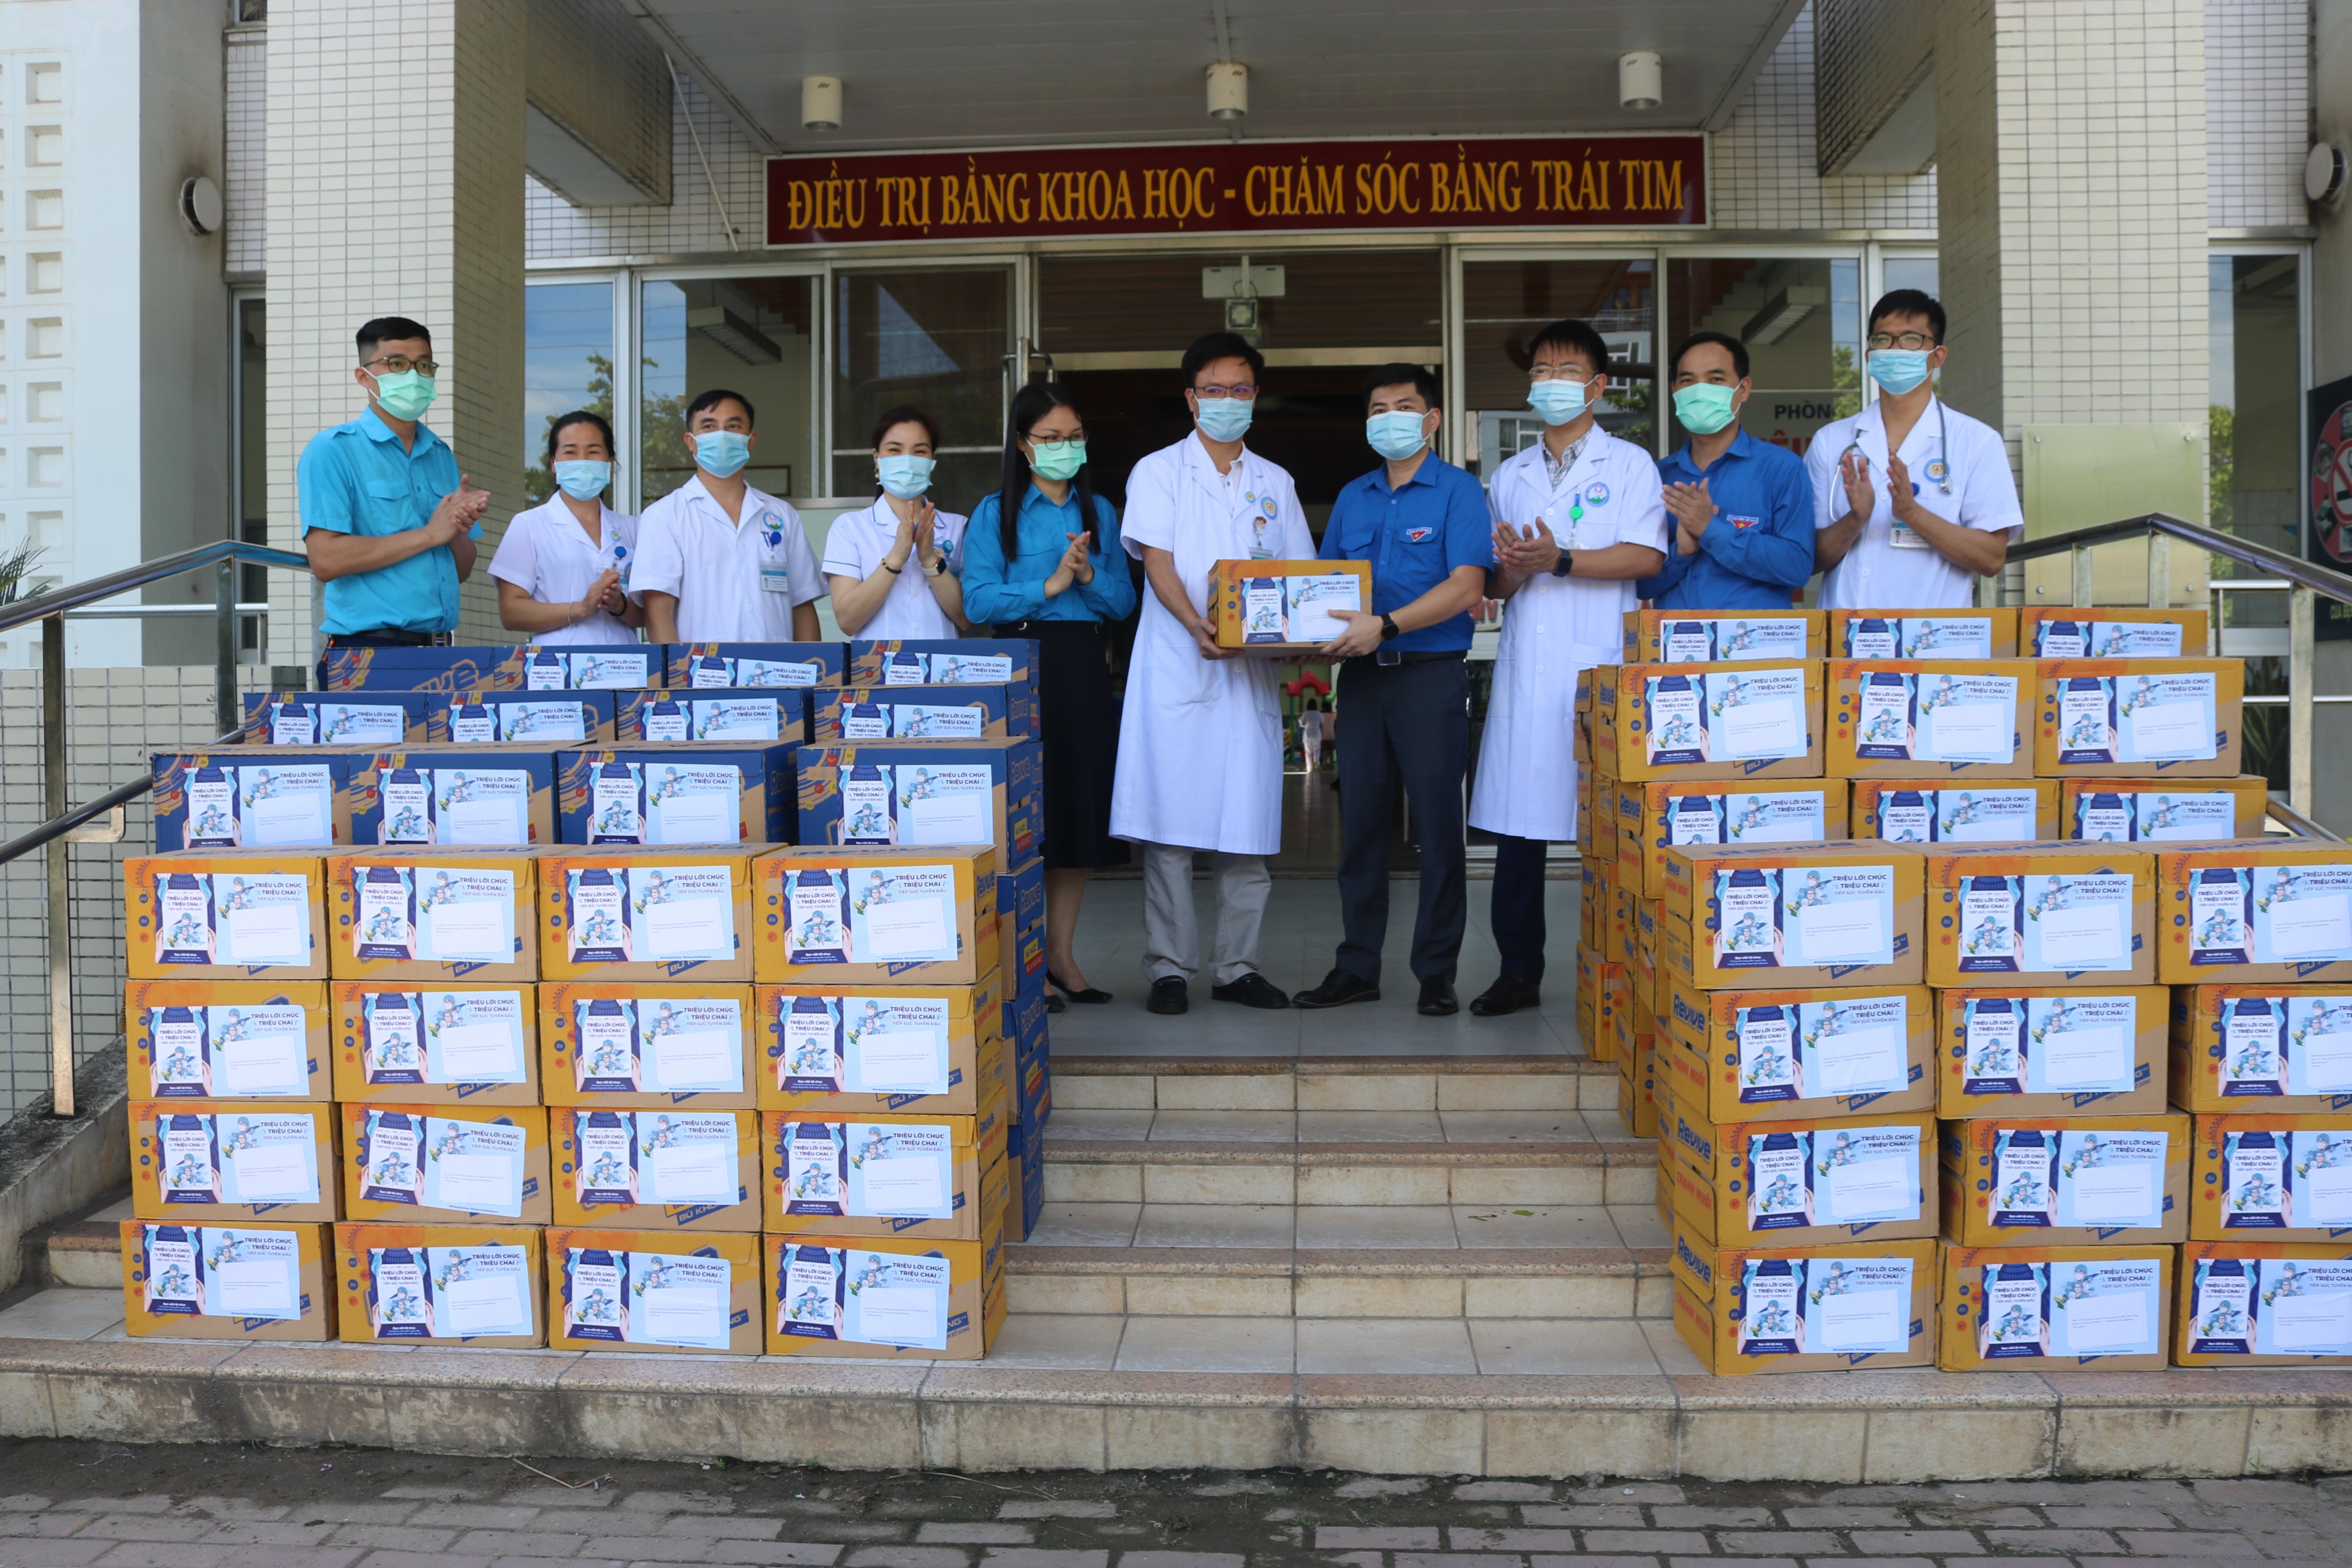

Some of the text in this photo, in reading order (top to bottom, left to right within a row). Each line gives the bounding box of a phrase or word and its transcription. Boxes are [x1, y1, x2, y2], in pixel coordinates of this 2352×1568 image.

[787, 143, 1683, 234] ĐIỀU TRỊ BẰNG KHOA HỌC - CHĂM SÓC BẰNG TRÁI TIM
[1775, 400, 1832, 419] PHÒN
[976, 869, 995, 900] Revive
[1832, 874, 1853, 882] TRIỆU
[1021, 882, 1041, 915] Revive
[1673, 992, 1705, 1035] Revive
[1848, 1003, 1868, 1011] TRIỆU
[1678, 1117, 1712, 1165] Revive
[1677, 1234, 1712, 1287] Revive
